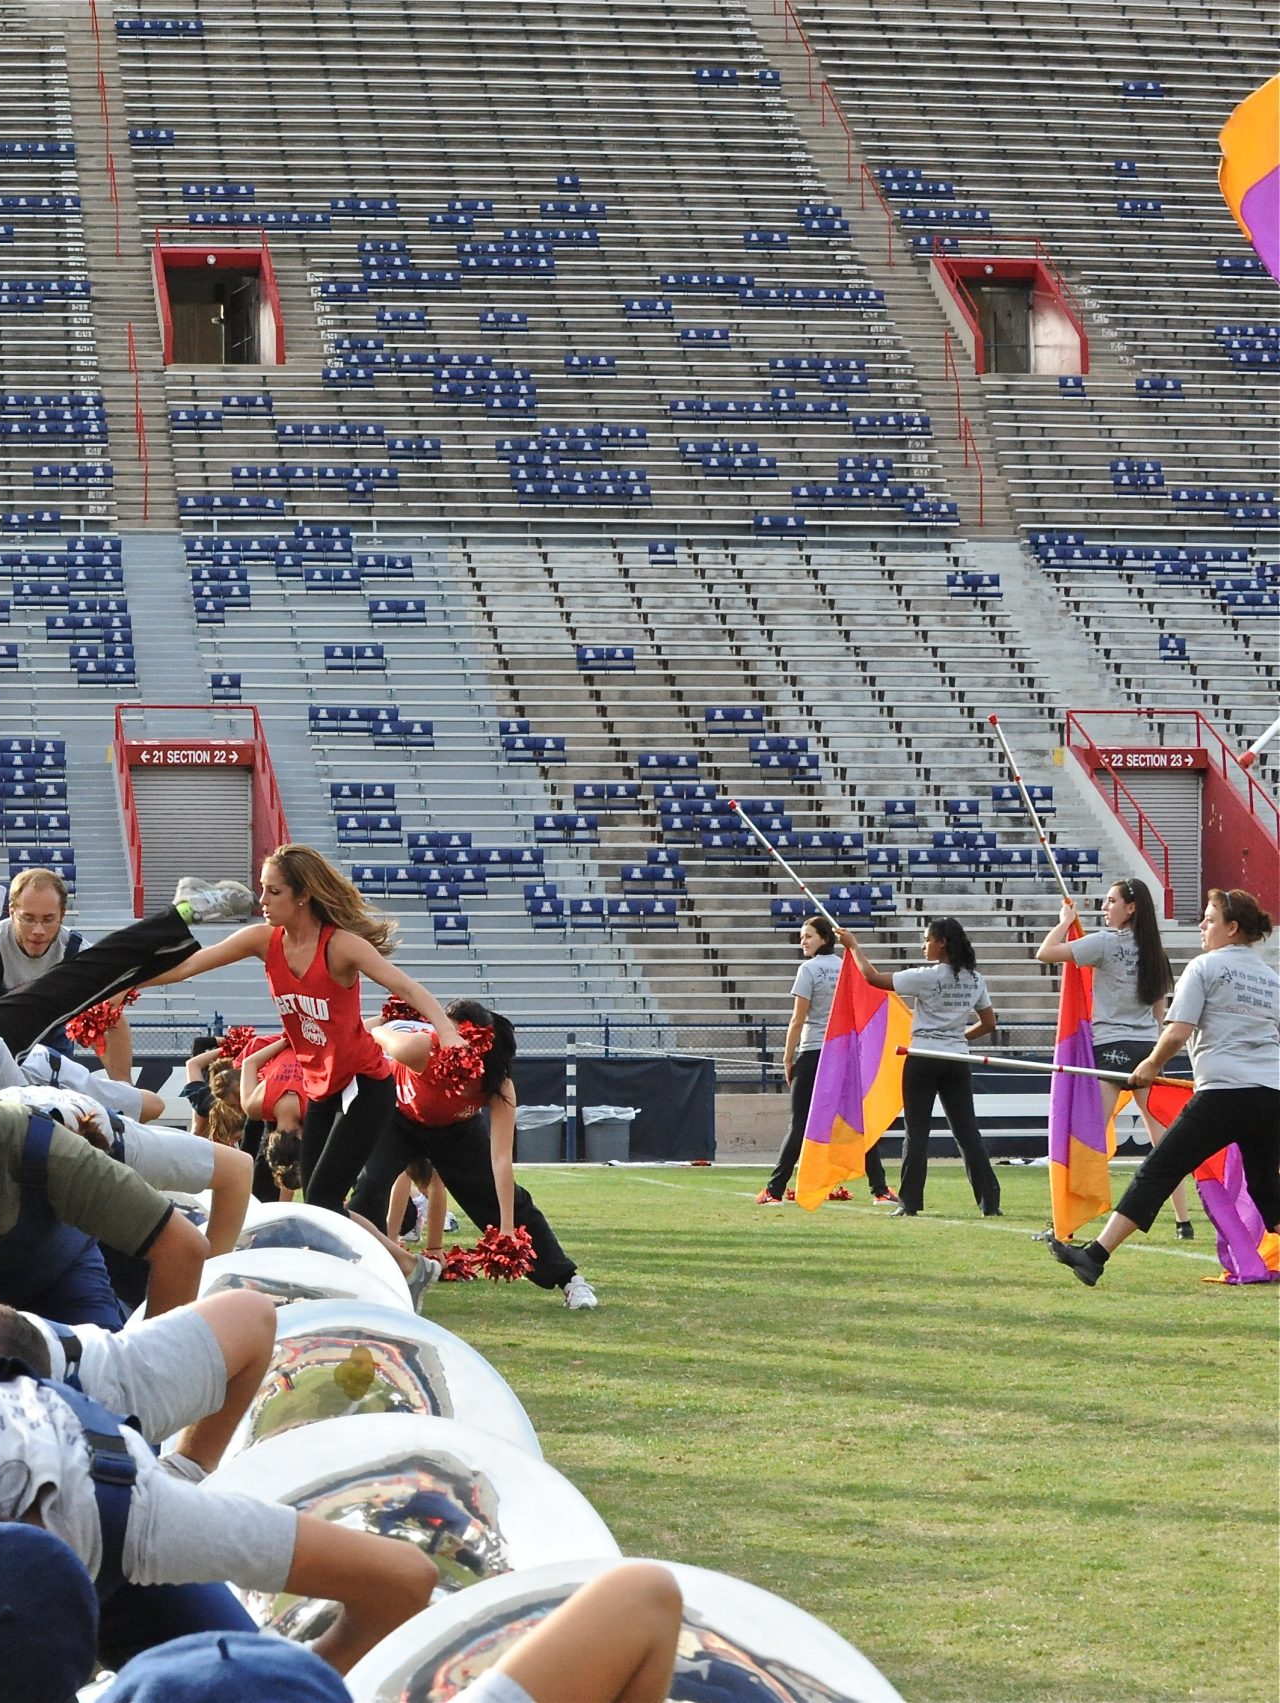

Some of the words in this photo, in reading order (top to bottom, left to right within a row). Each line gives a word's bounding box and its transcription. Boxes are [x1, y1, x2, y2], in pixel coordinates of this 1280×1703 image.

[153, 751, 163, 763] 21
[167, 751, 210, 763] SECTION
[214, 751, 226, 763] 22
[1111, 754, 1123, 767] 22
[1126, 754, 1168, 767] SECTION
[1170, 754, 1182, 767] 23
[275, 994, 298, 1015] GET
